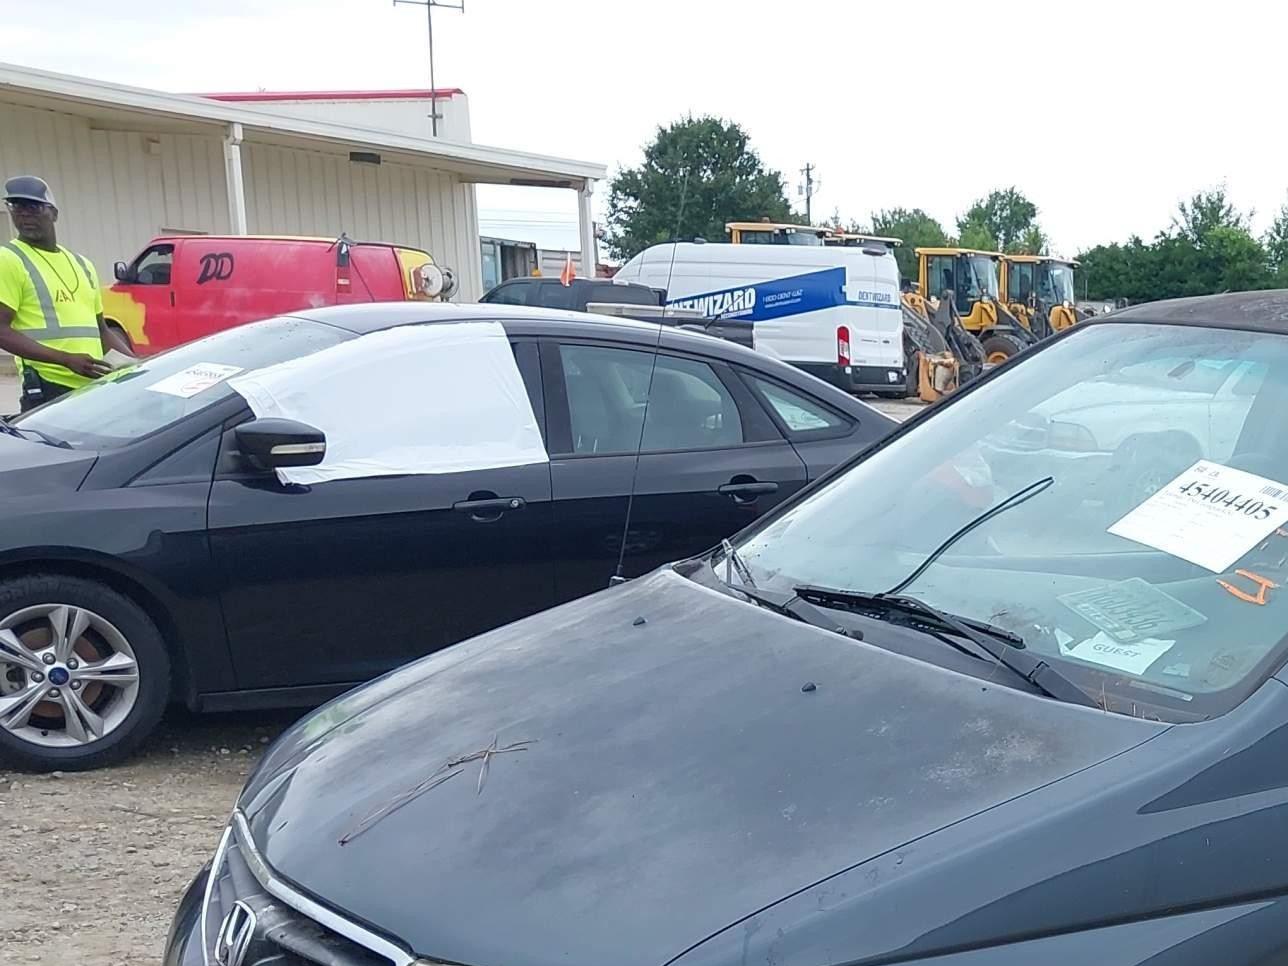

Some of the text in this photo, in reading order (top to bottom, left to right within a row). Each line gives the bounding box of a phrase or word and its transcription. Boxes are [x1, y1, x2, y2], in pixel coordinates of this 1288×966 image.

[196, 252, 234, 285] DD
[1179, 480, 1278, 520] 45404405
[1092, 643, 1142, 658] GUEST
